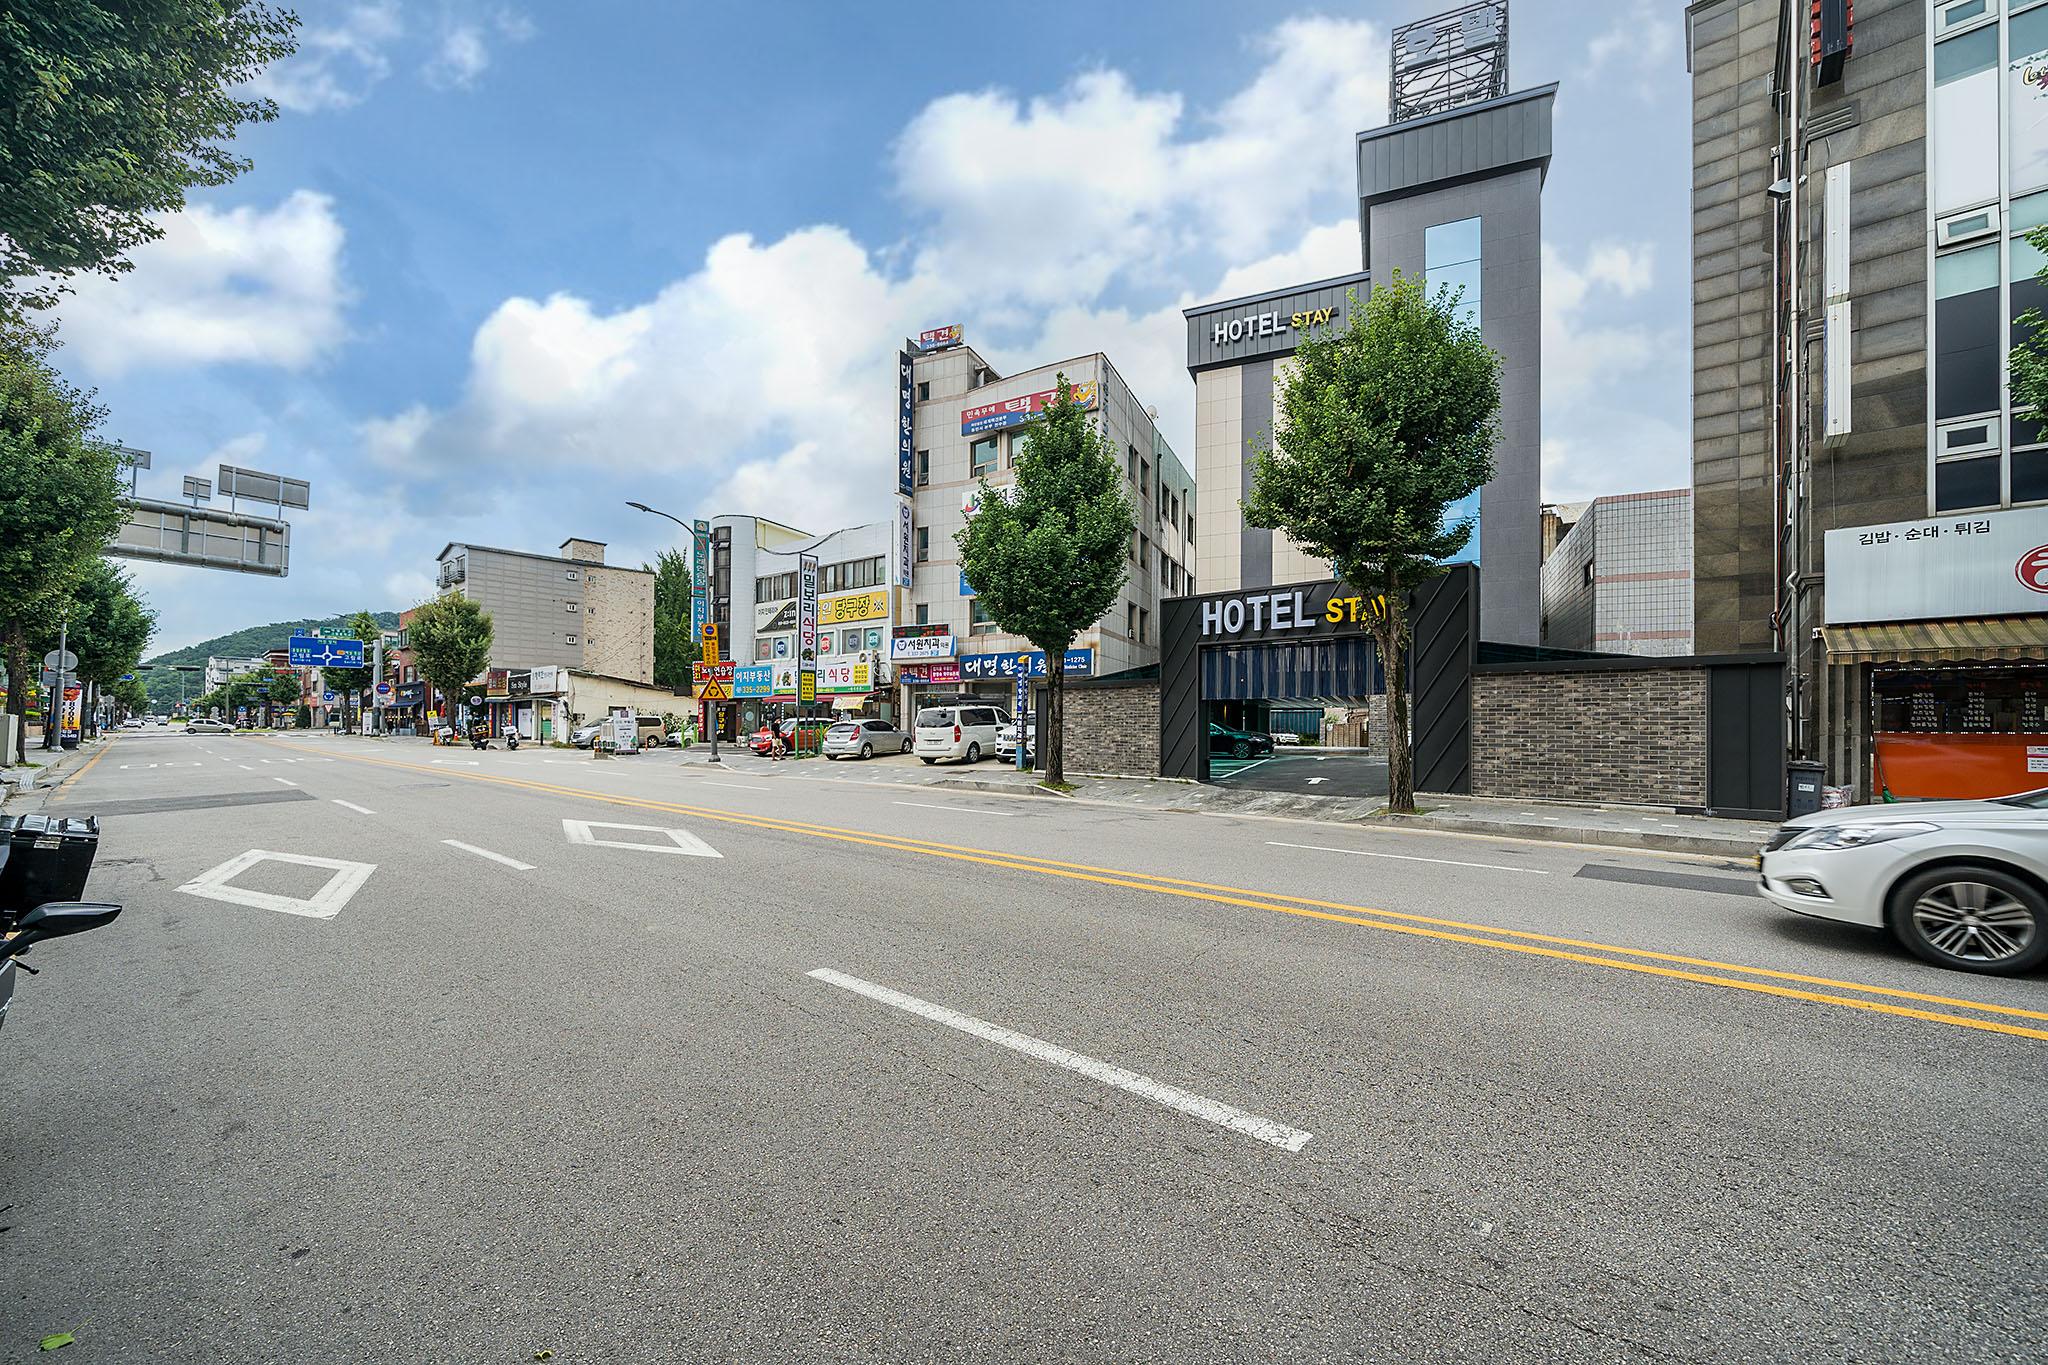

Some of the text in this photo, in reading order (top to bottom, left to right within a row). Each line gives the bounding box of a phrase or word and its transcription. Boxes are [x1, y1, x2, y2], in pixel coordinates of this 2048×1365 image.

[922, 328, 949, 342] 택견
[1214, 306, 1333, 344] HOTEL STAY
[900, 364, 912, 479] 대명한의원
[966, 405, 996, 419] 민속무예
[1859, 520, 1991, 546] 김밥 순대 튀김
[803, 574, 816, 646] 밀보리식당
[834, 594, 870, 620] 당구장
[1202, 591, 1316, 636] HOTEL
[735, 670, 771, 683] 이지부동산
